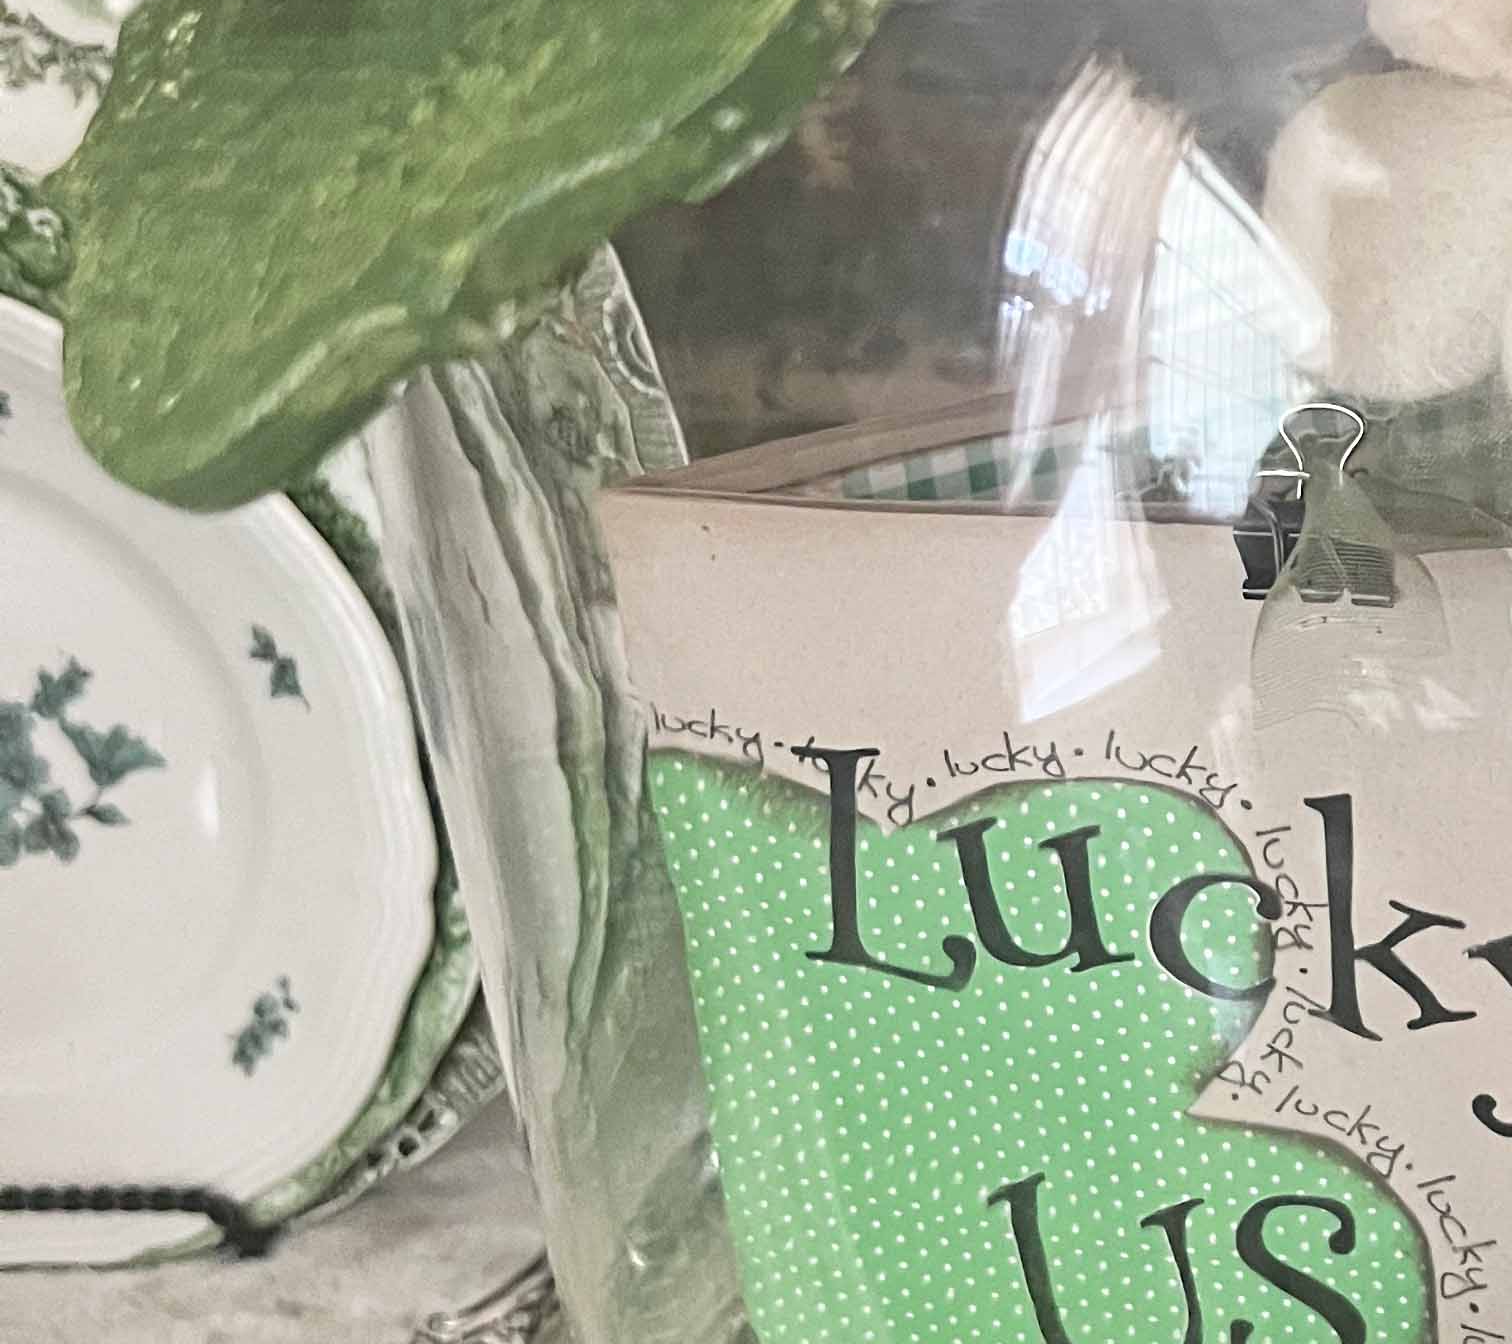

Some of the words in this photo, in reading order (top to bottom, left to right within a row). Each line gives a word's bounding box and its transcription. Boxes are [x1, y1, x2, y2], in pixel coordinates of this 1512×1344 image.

[943, 731, 1066, 778] lucky
[1104, 730, 1240, 809] lucky
[1254, 824, 1329, 950] lucky
[1274, 1083, 1406, 1177] lucky
[1416, 1173, 1498, 1313] lucky
